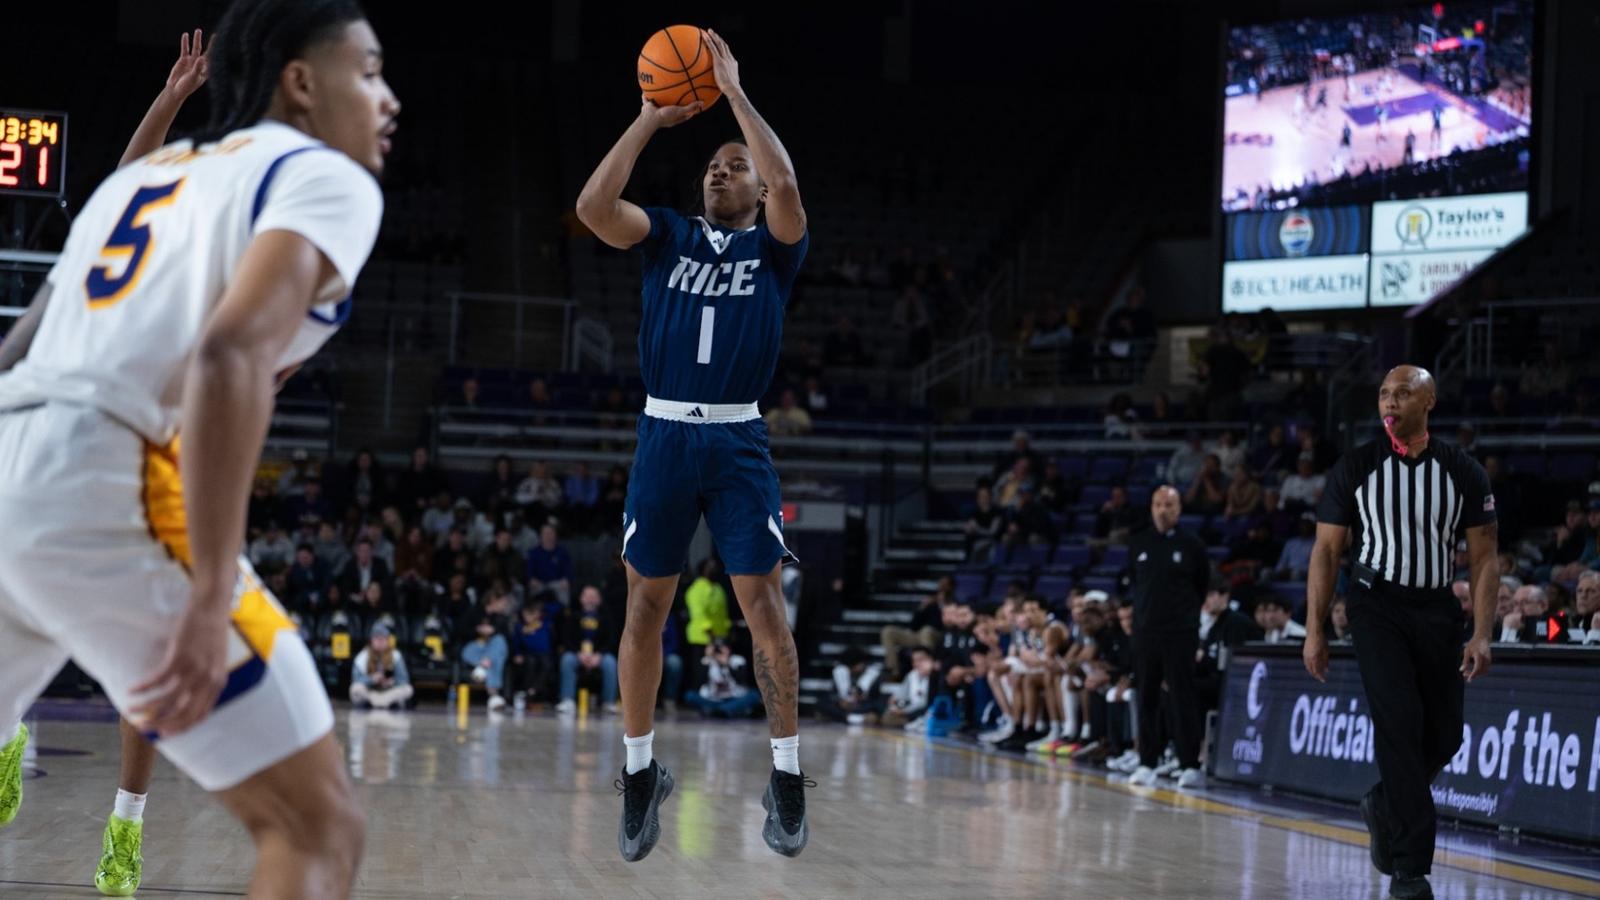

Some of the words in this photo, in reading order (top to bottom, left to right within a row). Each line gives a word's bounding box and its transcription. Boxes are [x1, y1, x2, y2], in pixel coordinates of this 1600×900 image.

[0, 142, 48, 186] 21
[1437, 205, 1504, 226] Taylor's
[84, 175, 187, 310] 5
[667, 255, 761, 297] RICE
[1290, 273, 1363, 294] HEALTH
[697, 306, 715, 364] 1
[1290, 694, 1374, 763] Official
[1478, 709, 1520, 780] of
[1523, 712, 1581, 790] the
